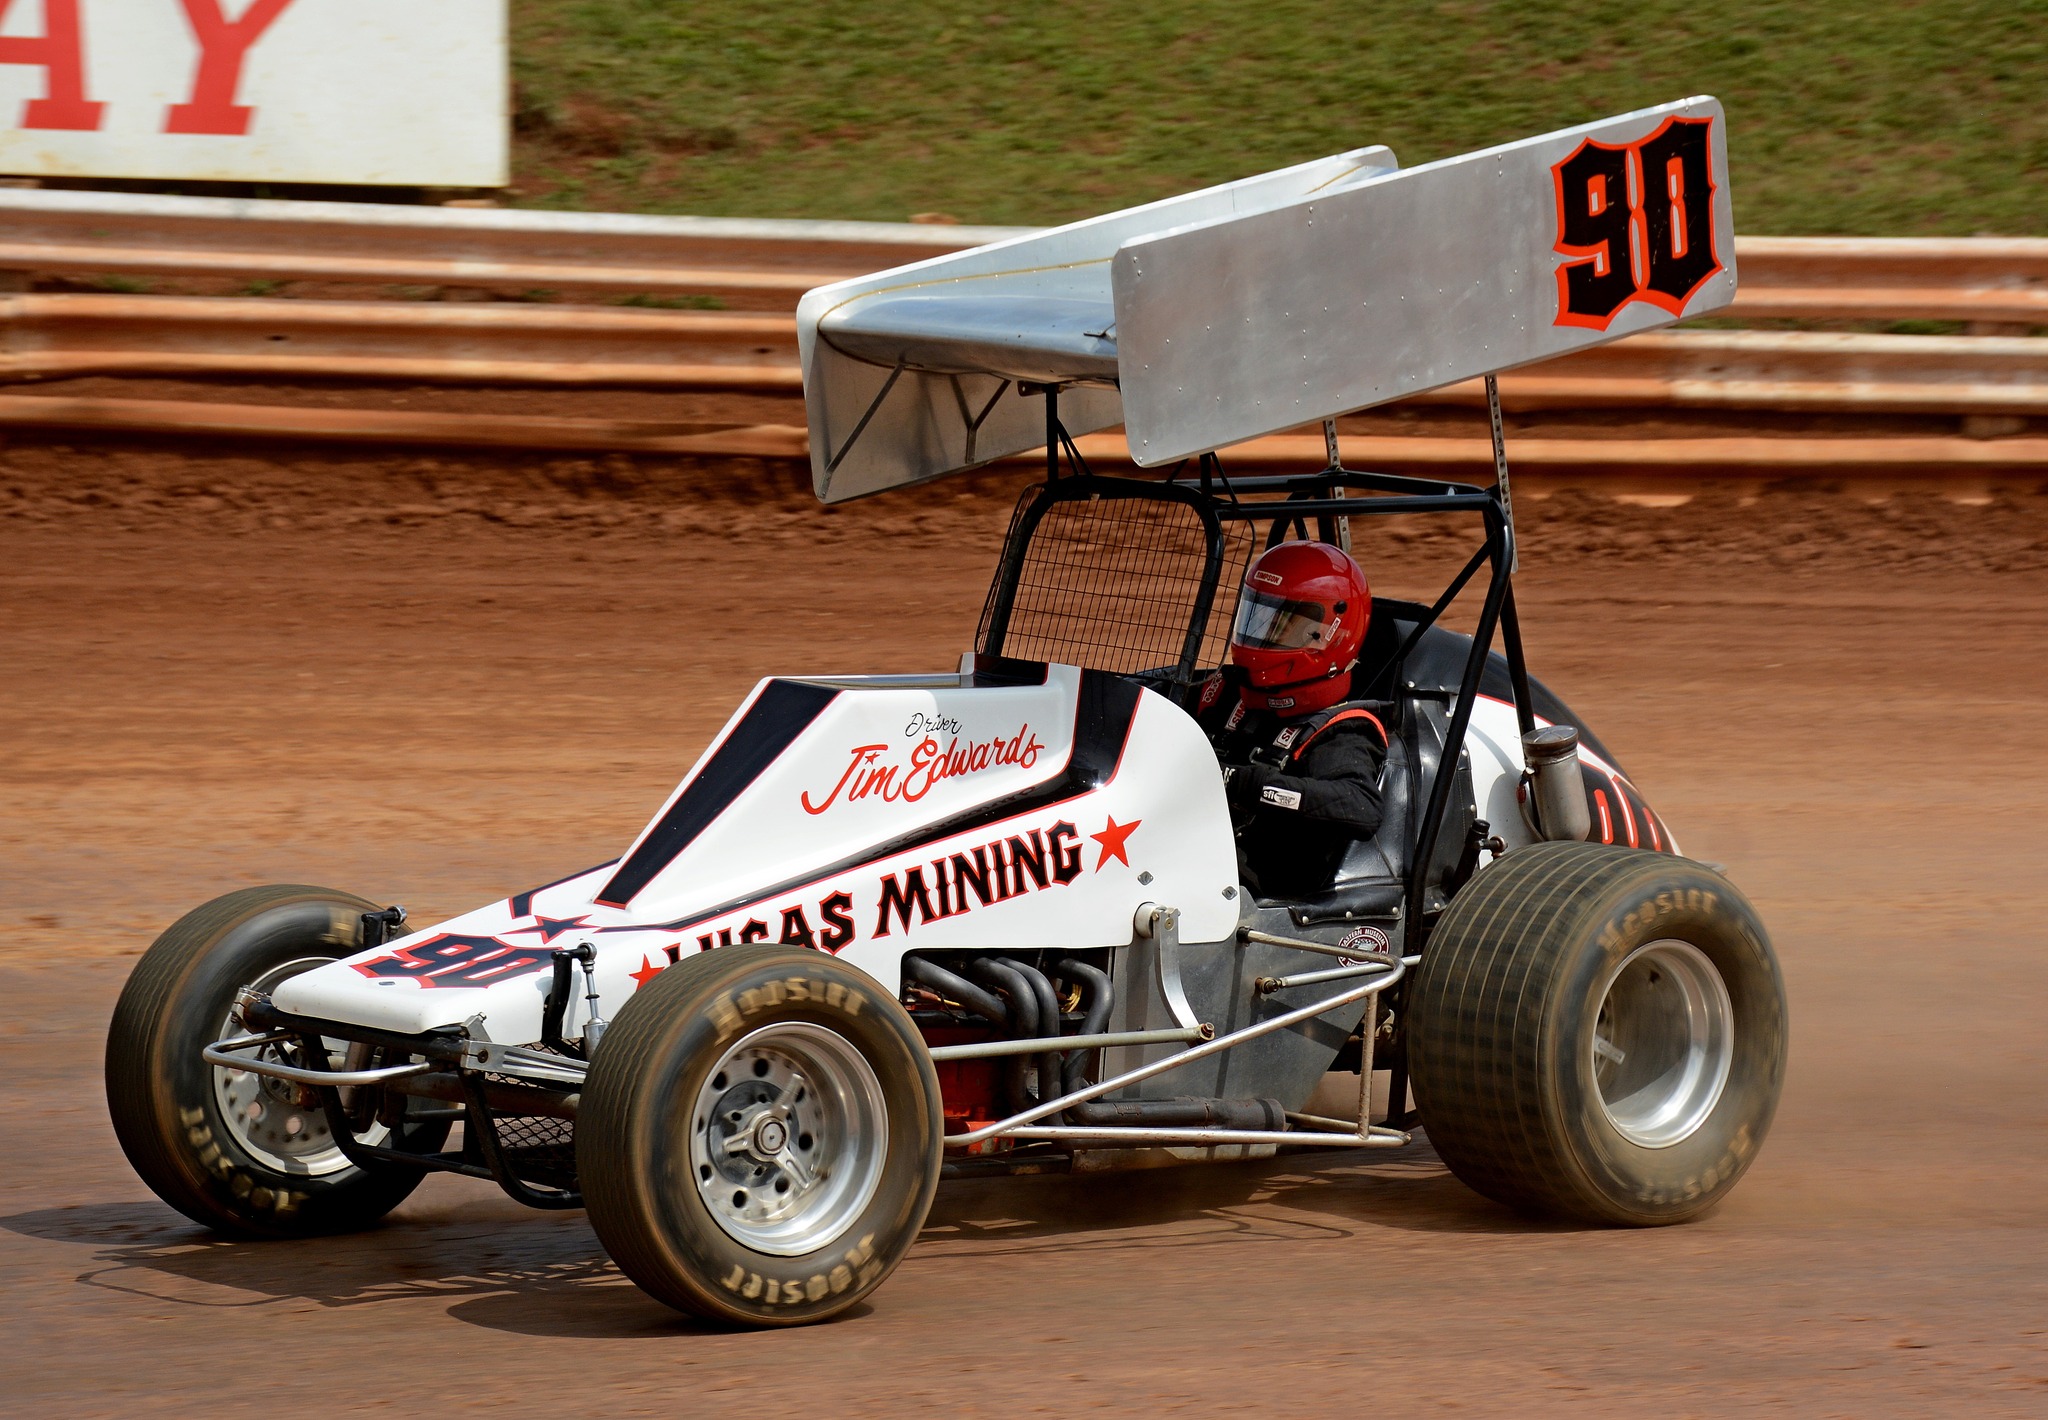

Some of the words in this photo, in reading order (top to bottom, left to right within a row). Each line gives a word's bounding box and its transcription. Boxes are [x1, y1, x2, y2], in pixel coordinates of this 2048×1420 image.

[1550, 114, 1724, 332] 90
[905, 712, 963, 738] Driver
[801, 743, 903, 815] Jim
[900, 724, 1045, 802] Edwards
[872, 819, 1084, 939] MINING
[348, 932, 564, 989] 90
[1364, 929, 1386, 946] MUSEUM
